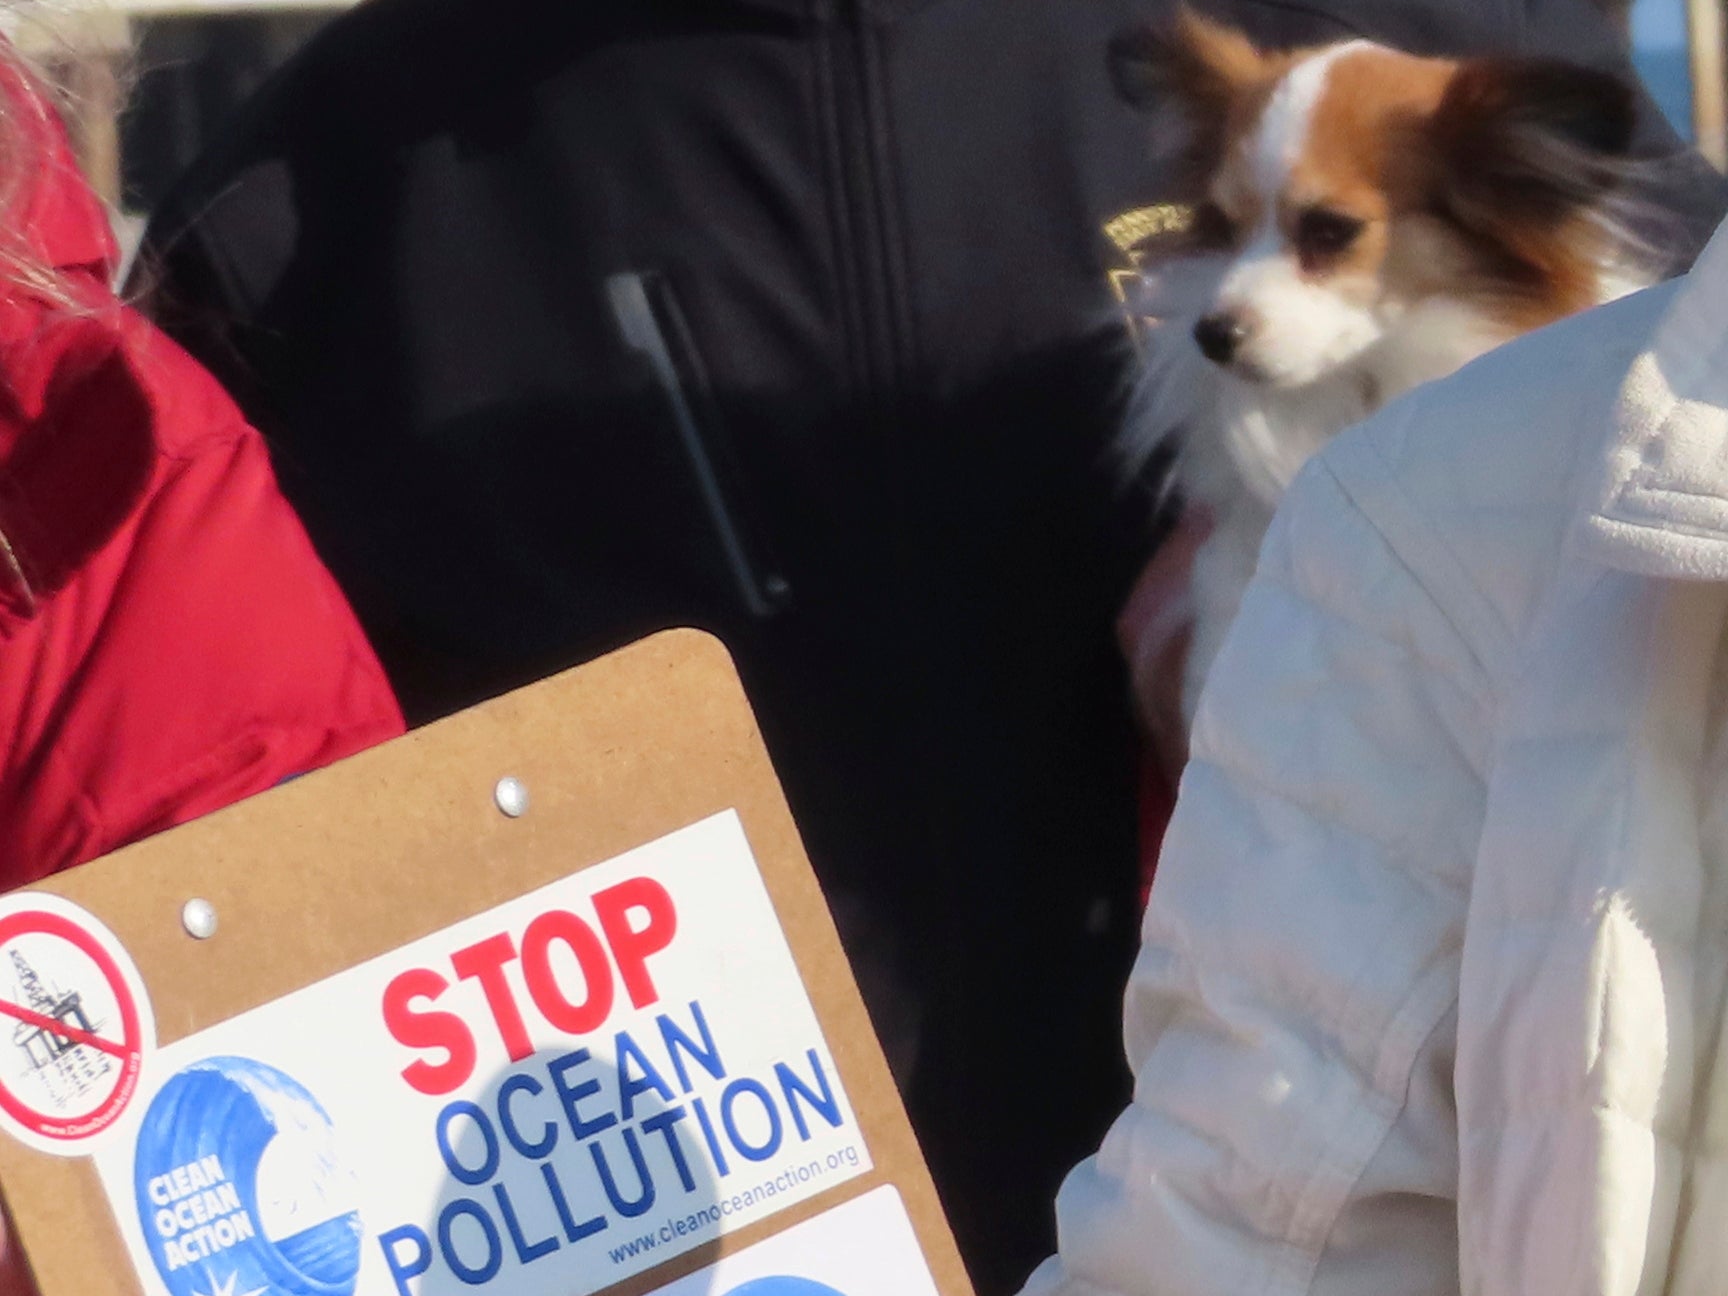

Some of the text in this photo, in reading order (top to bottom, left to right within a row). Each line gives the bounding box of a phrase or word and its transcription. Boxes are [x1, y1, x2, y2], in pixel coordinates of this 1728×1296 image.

[382, 876, 677, 1095] STOP
[436, 1000, 727, 1185] OCEAN
[148, 1154, 225, 1205] CLEAN
[155, 1181, 241, 1238] OCEAN
[608, 1144, 860, 1265] www.cleanoceanaction.org
[163, 1210, 255, 1272] ACTION
